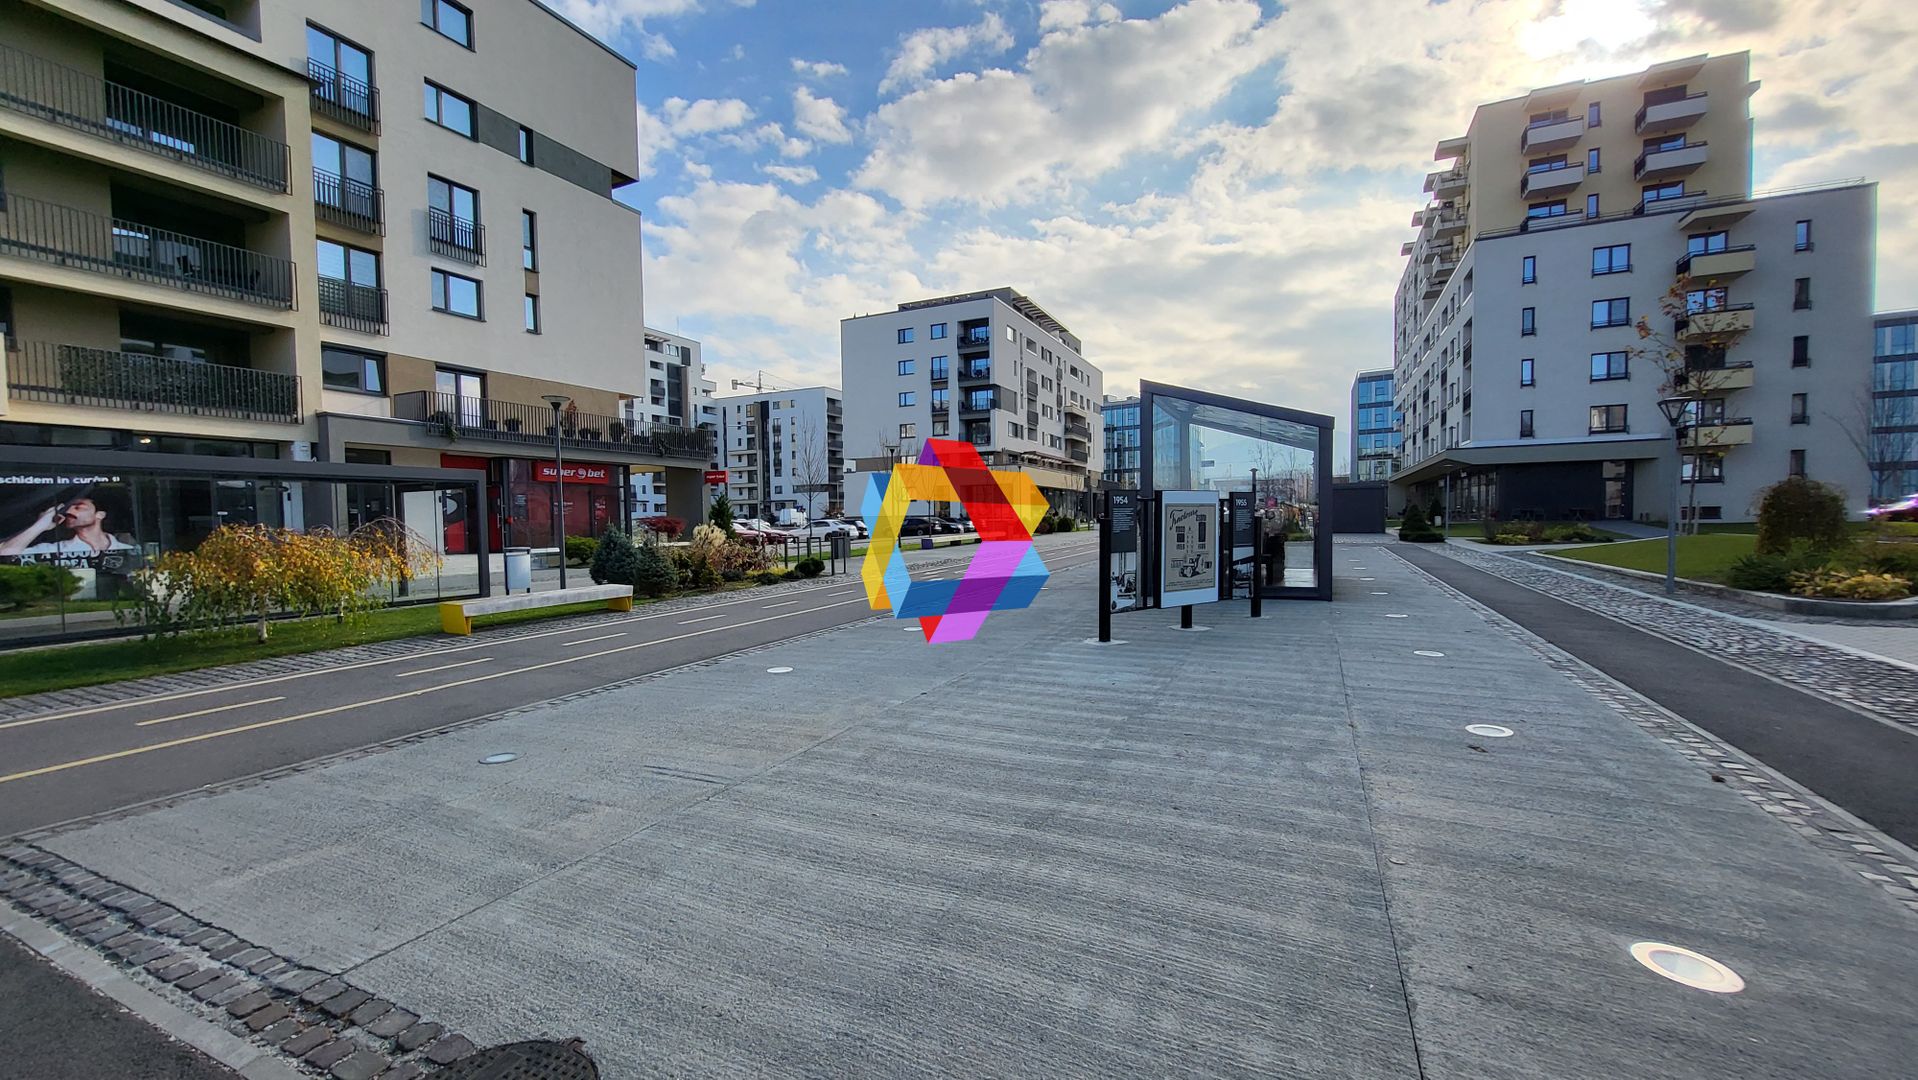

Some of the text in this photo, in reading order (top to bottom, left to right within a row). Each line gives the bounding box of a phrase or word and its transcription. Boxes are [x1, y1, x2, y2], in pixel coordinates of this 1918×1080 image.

[587, 469, 606, 478] bet
[57, 476, 70, 484] in
[1113, 495, 1128, 504] 1954
[1235, 498, 1247, 506] 1955
